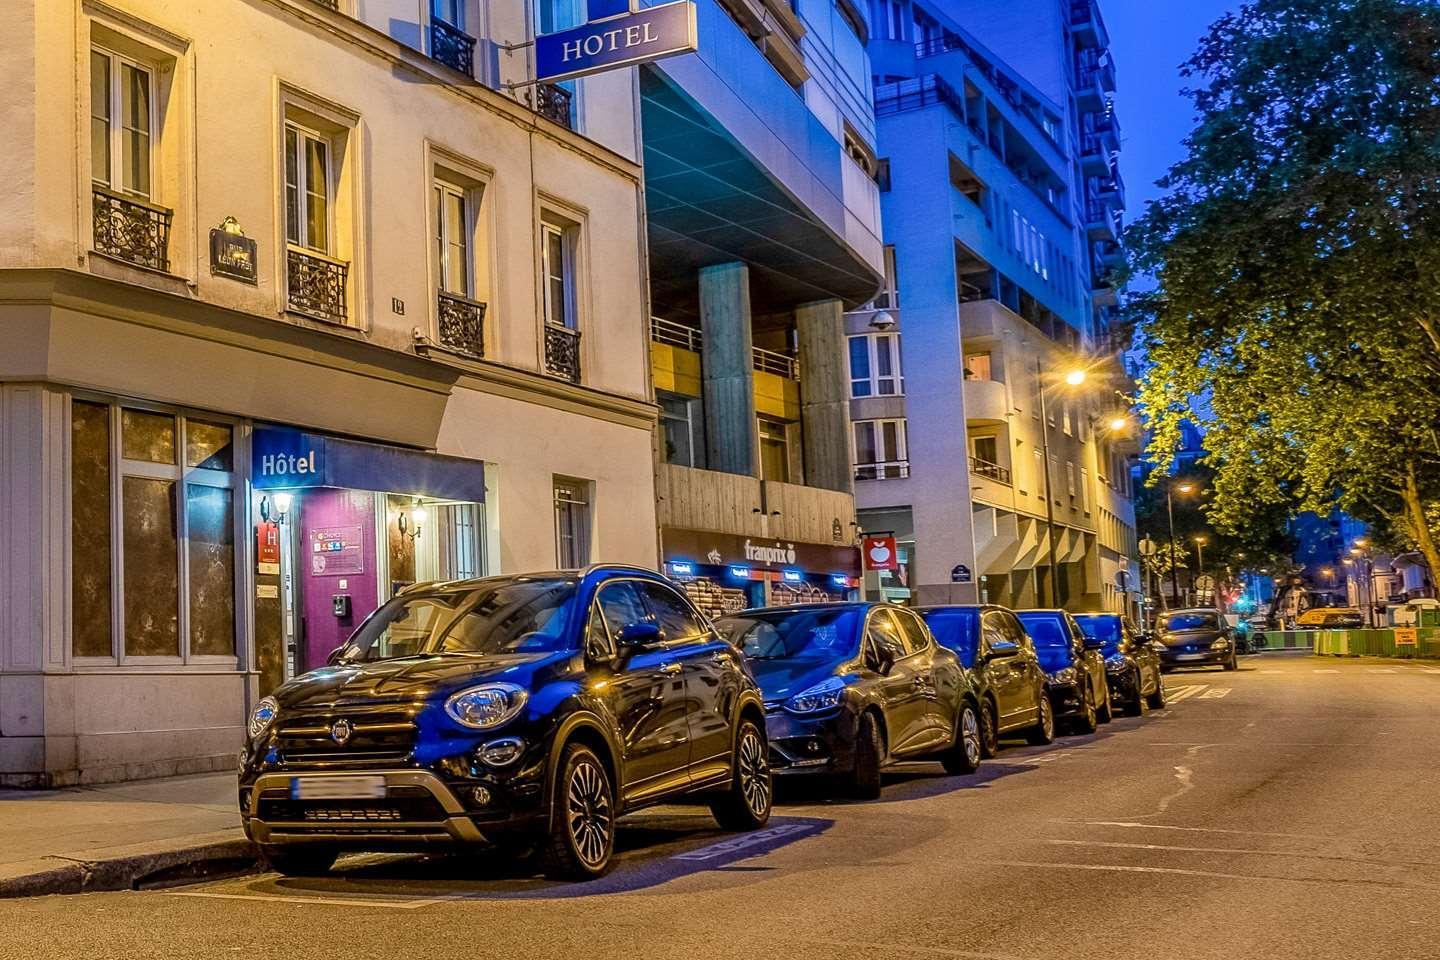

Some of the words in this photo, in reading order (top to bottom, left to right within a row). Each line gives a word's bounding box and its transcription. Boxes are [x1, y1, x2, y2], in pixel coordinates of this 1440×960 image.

[562, 22, 659, 62] HOTEL
[262, 450, 316, 476] Hôtel
[267, 530, 277, 546] H
[744, 539, 787, 566] franprix
